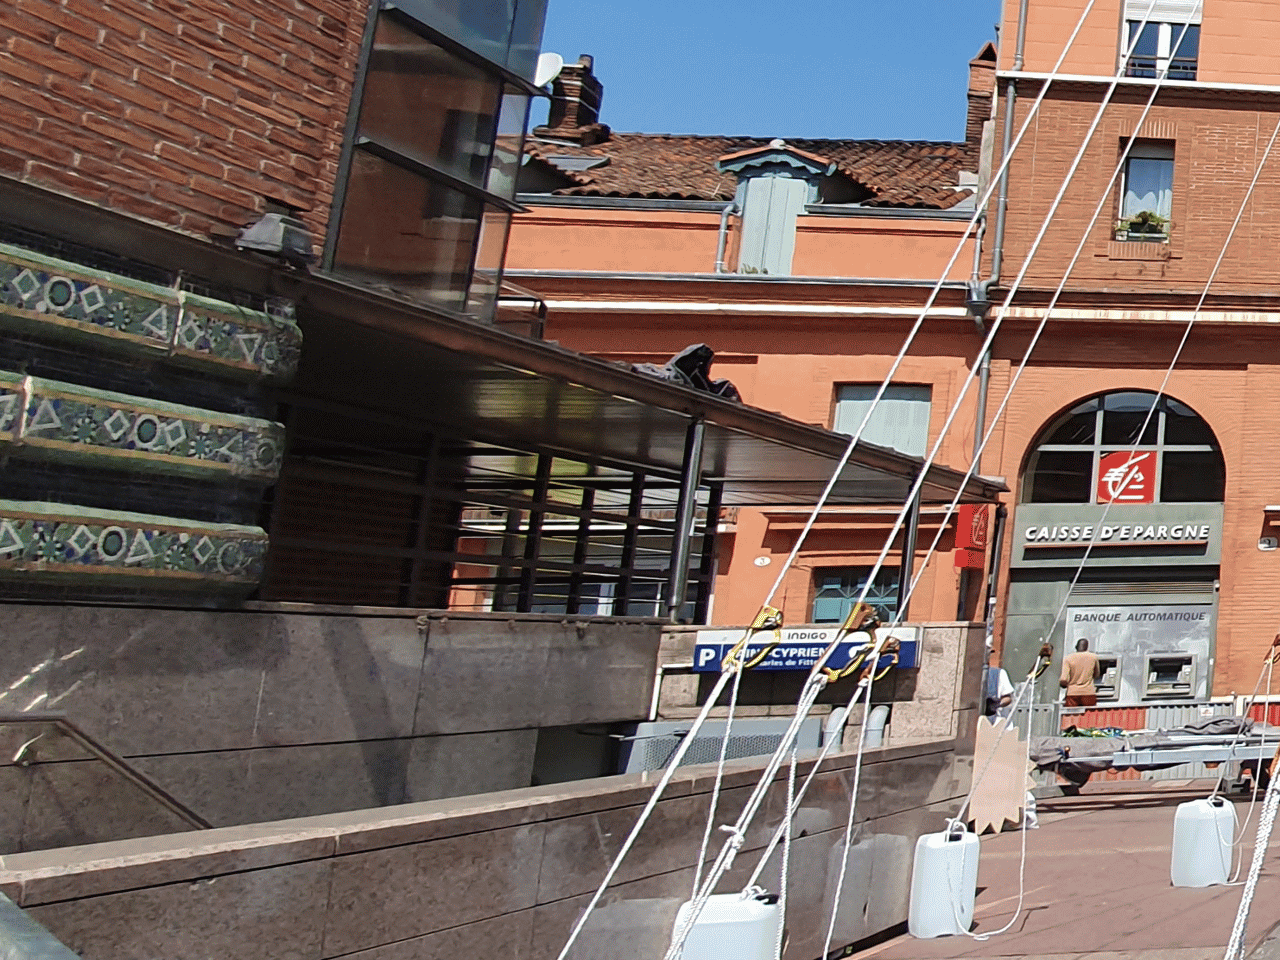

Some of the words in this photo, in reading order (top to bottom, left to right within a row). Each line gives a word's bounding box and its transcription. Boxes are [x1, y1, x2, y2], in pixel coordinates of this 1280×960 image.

[1025, 526, 1094, 540] CAISSE
[1101, 525, 1211, 540] D'EPARGNE
[1073, 613, 1122, 623] BANQUE
[1126, 611, 1207, 622] AUTOMATIQUE
[787, 632, 828, 640] INDIGO
[698, 648, 716, 667] P
